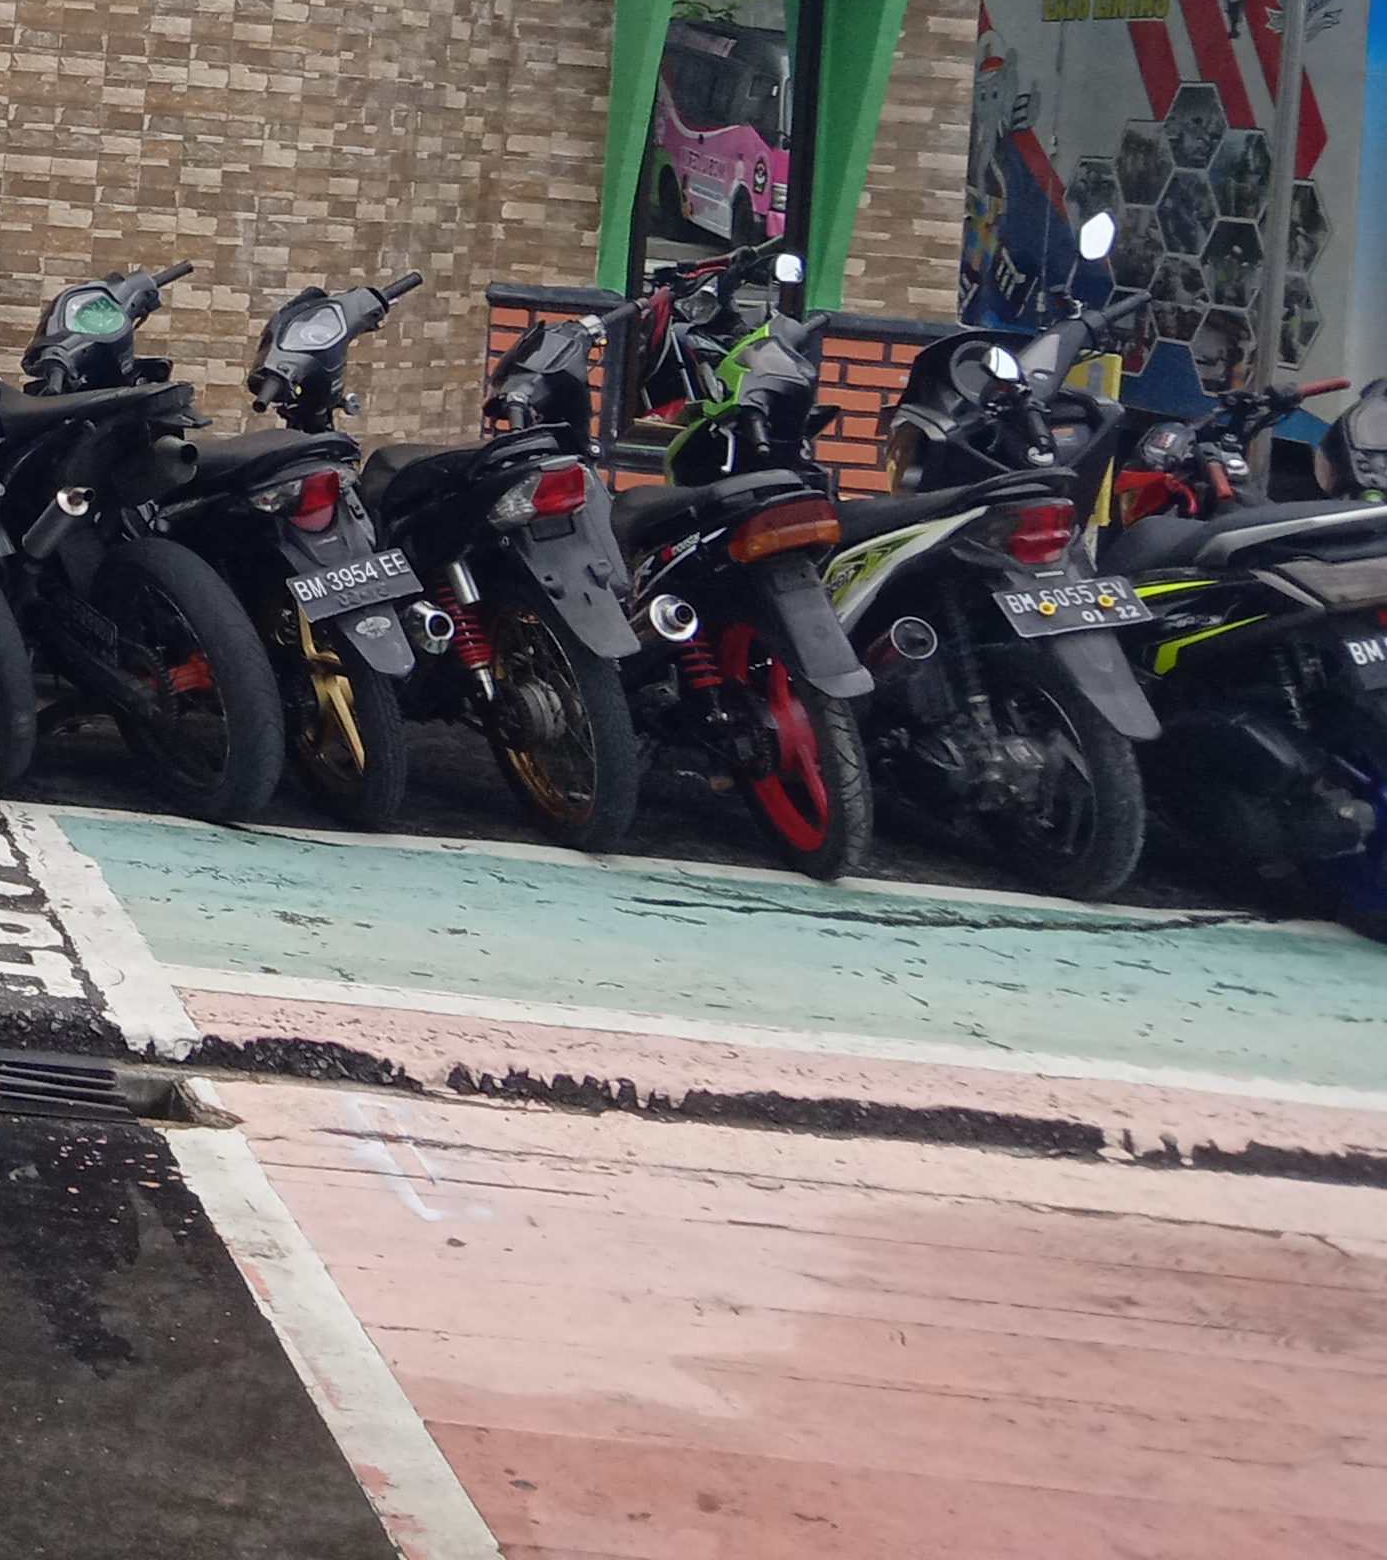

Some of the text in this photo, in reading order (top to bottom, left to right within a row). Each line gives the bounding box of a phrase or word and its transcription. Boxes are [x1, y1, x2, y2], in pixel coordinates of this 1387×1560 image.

[293, 576, 327, 602] BM
[326, 560, 379, 591] 3954
[378, 553, 411, 577] EE
[1005, 592, 1039, 614] BM
[1038, 584, 1096, 612] 6055
[1081, 605, 1142, 623] 01 22
[1347, 640, 1385, 665] BM
